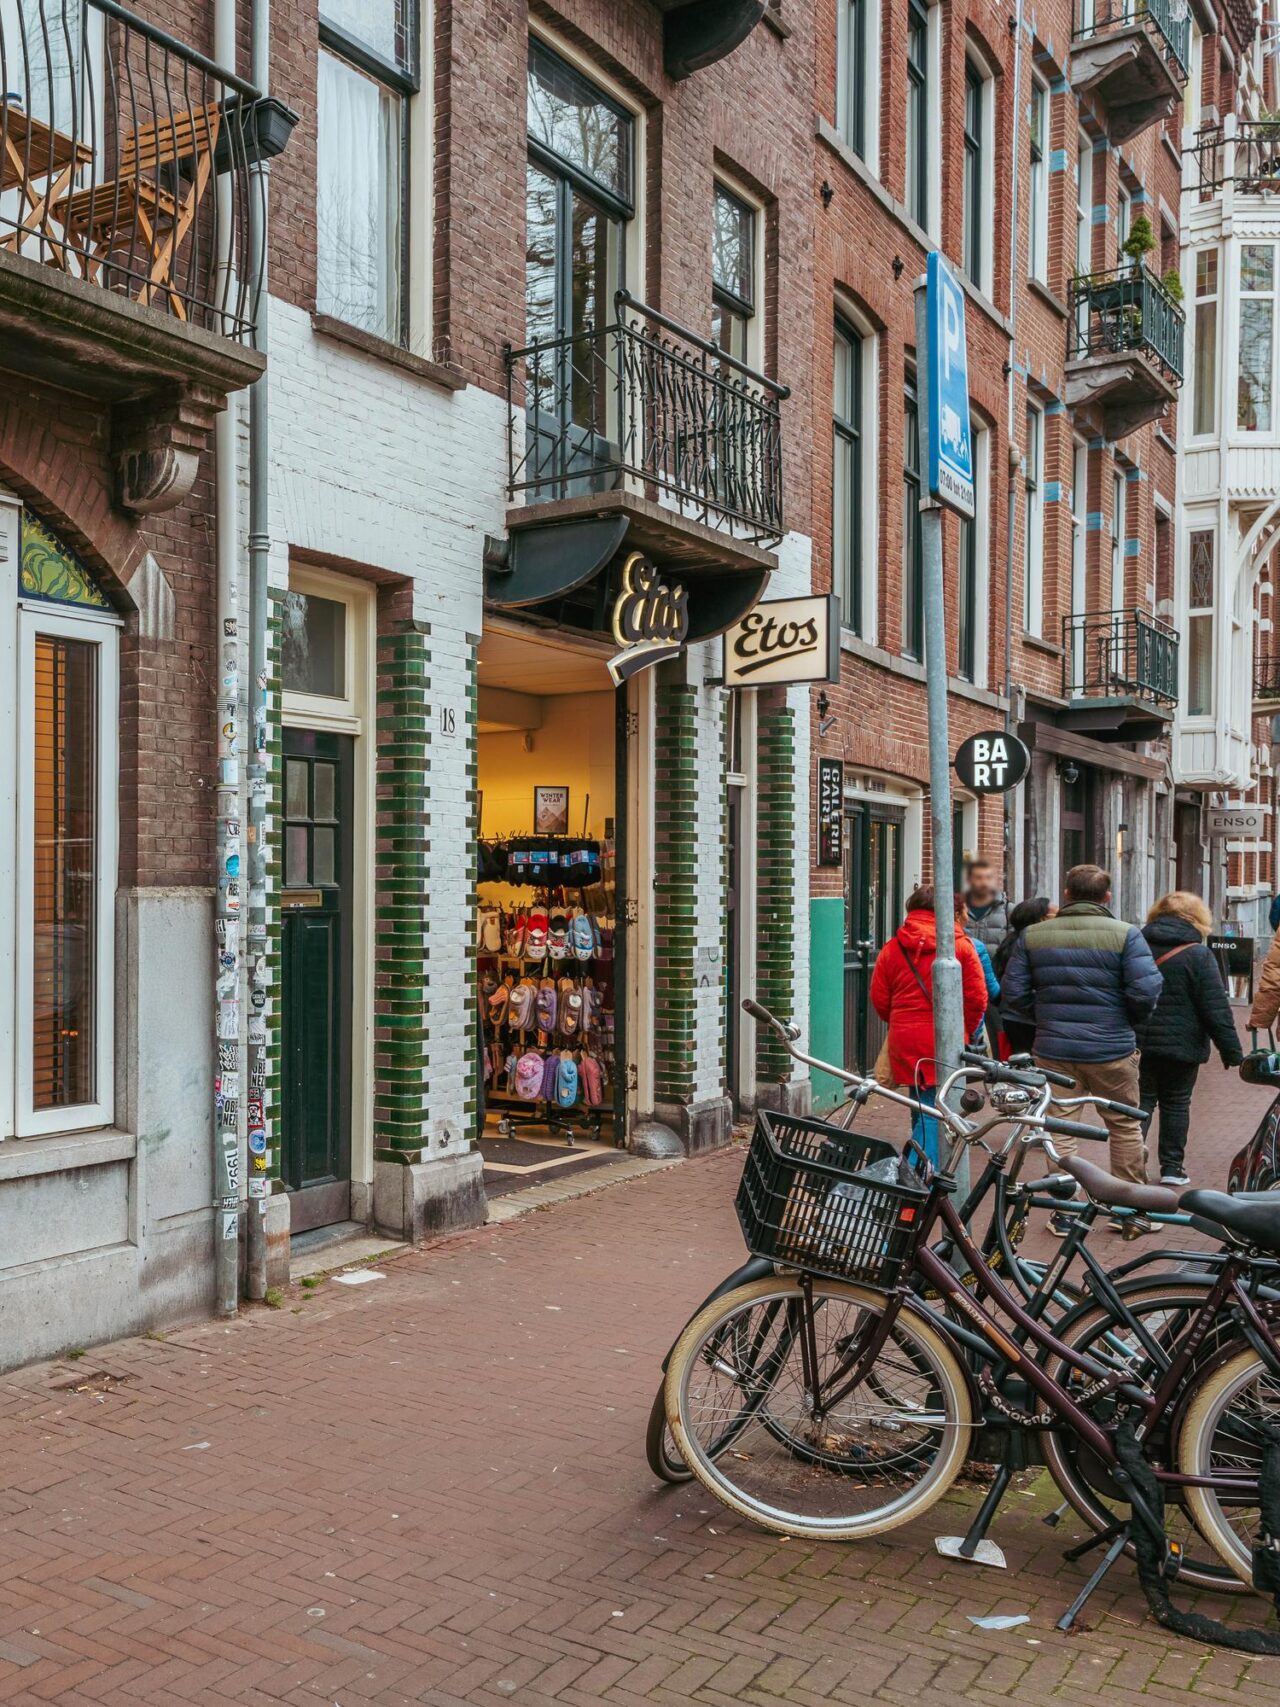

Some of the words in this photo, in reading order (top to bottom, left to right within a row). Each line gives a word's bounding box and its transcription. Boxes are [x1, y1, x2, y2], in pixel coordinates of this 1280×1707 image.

[944, 282, 959, 380] P
[734, 613, 818, 657] Etos
[443, 708, 455, 733] 18
[954, 1291, 987, 1328] SPARTA
